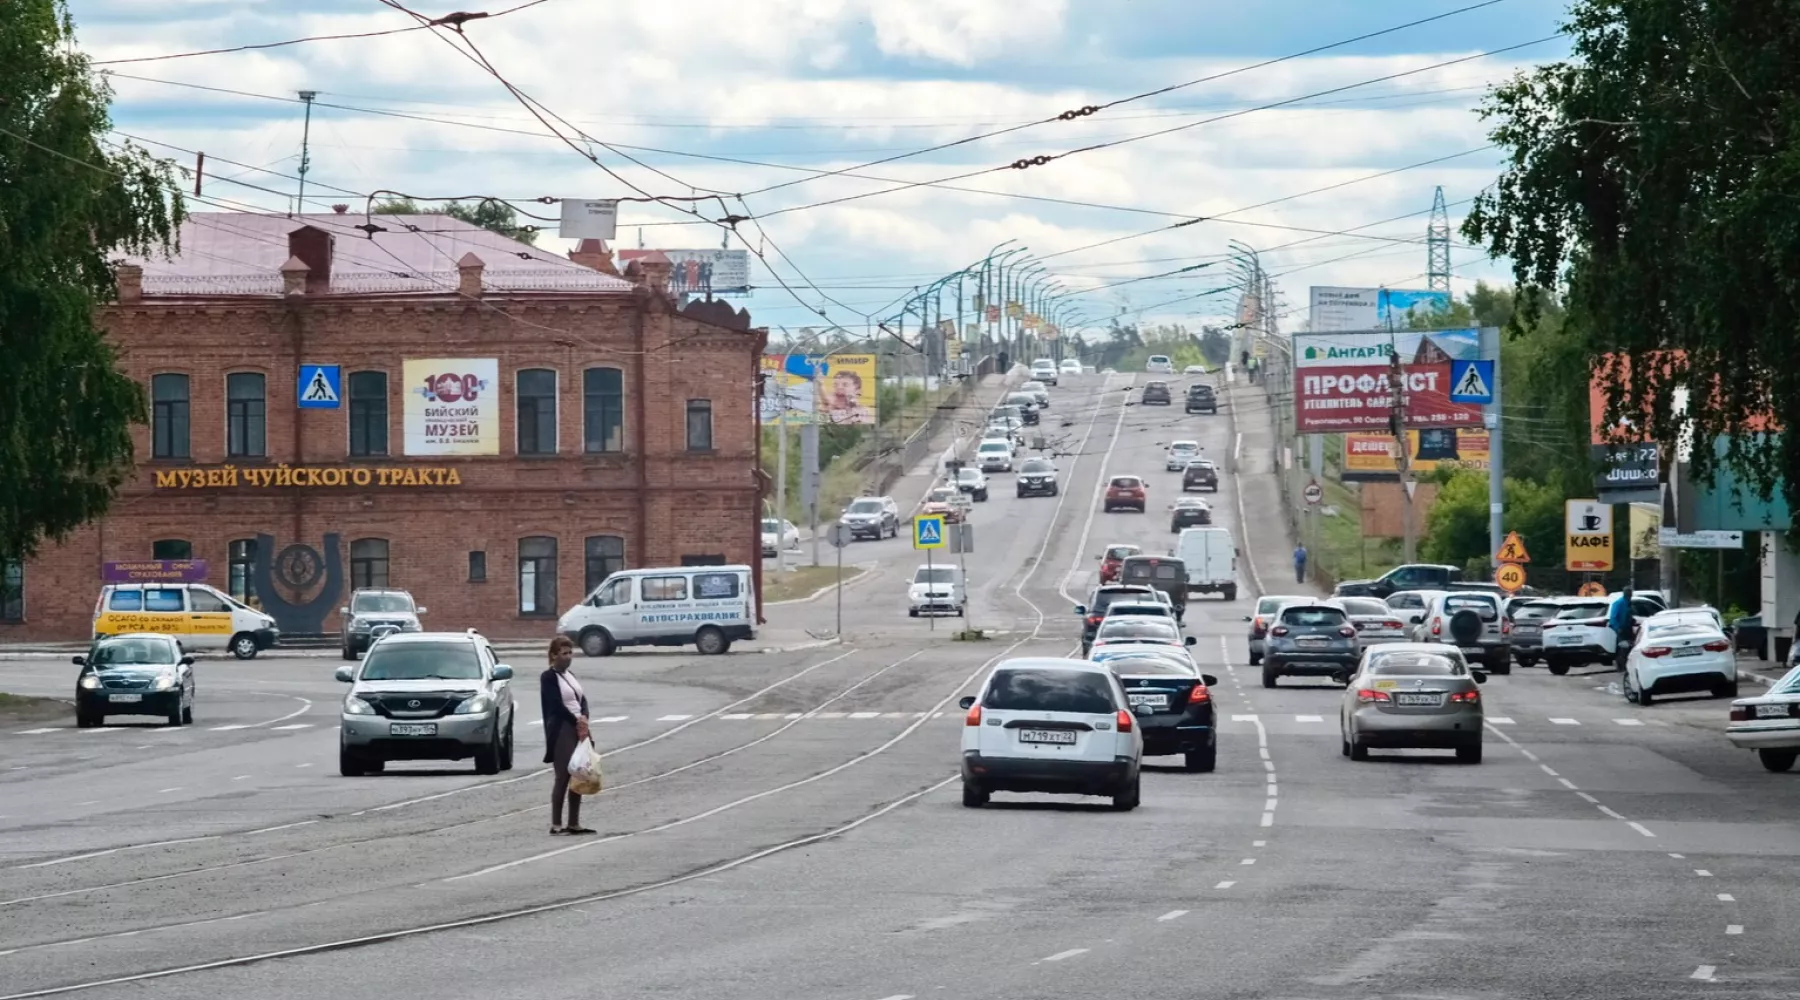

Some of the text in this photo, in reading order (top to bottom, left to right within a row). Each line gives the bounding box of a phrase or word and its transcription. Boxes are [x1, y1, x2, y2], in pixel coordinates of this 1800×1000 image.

[425, 405, 479, 417] БИЙСКИЙ
[425, 420, 479, 436] МУЗЕЙ
[155, 463, 461, 488] МУЗЕЙ ЧУЙСКОГО ТРАКТА
[1570, 536, 1609, 548] КАФЕ
[172, 562, 195, 570] ОФИС
[1502, 572, 1519, 583] 40
[108, 614, 137, 623] ОСАГО
[640, 611, 742, 624] АВТОСТРАХОВАНИЕ
[128, 623, 145, 631] РСА
[1063, 731, 1073, 739] 22
